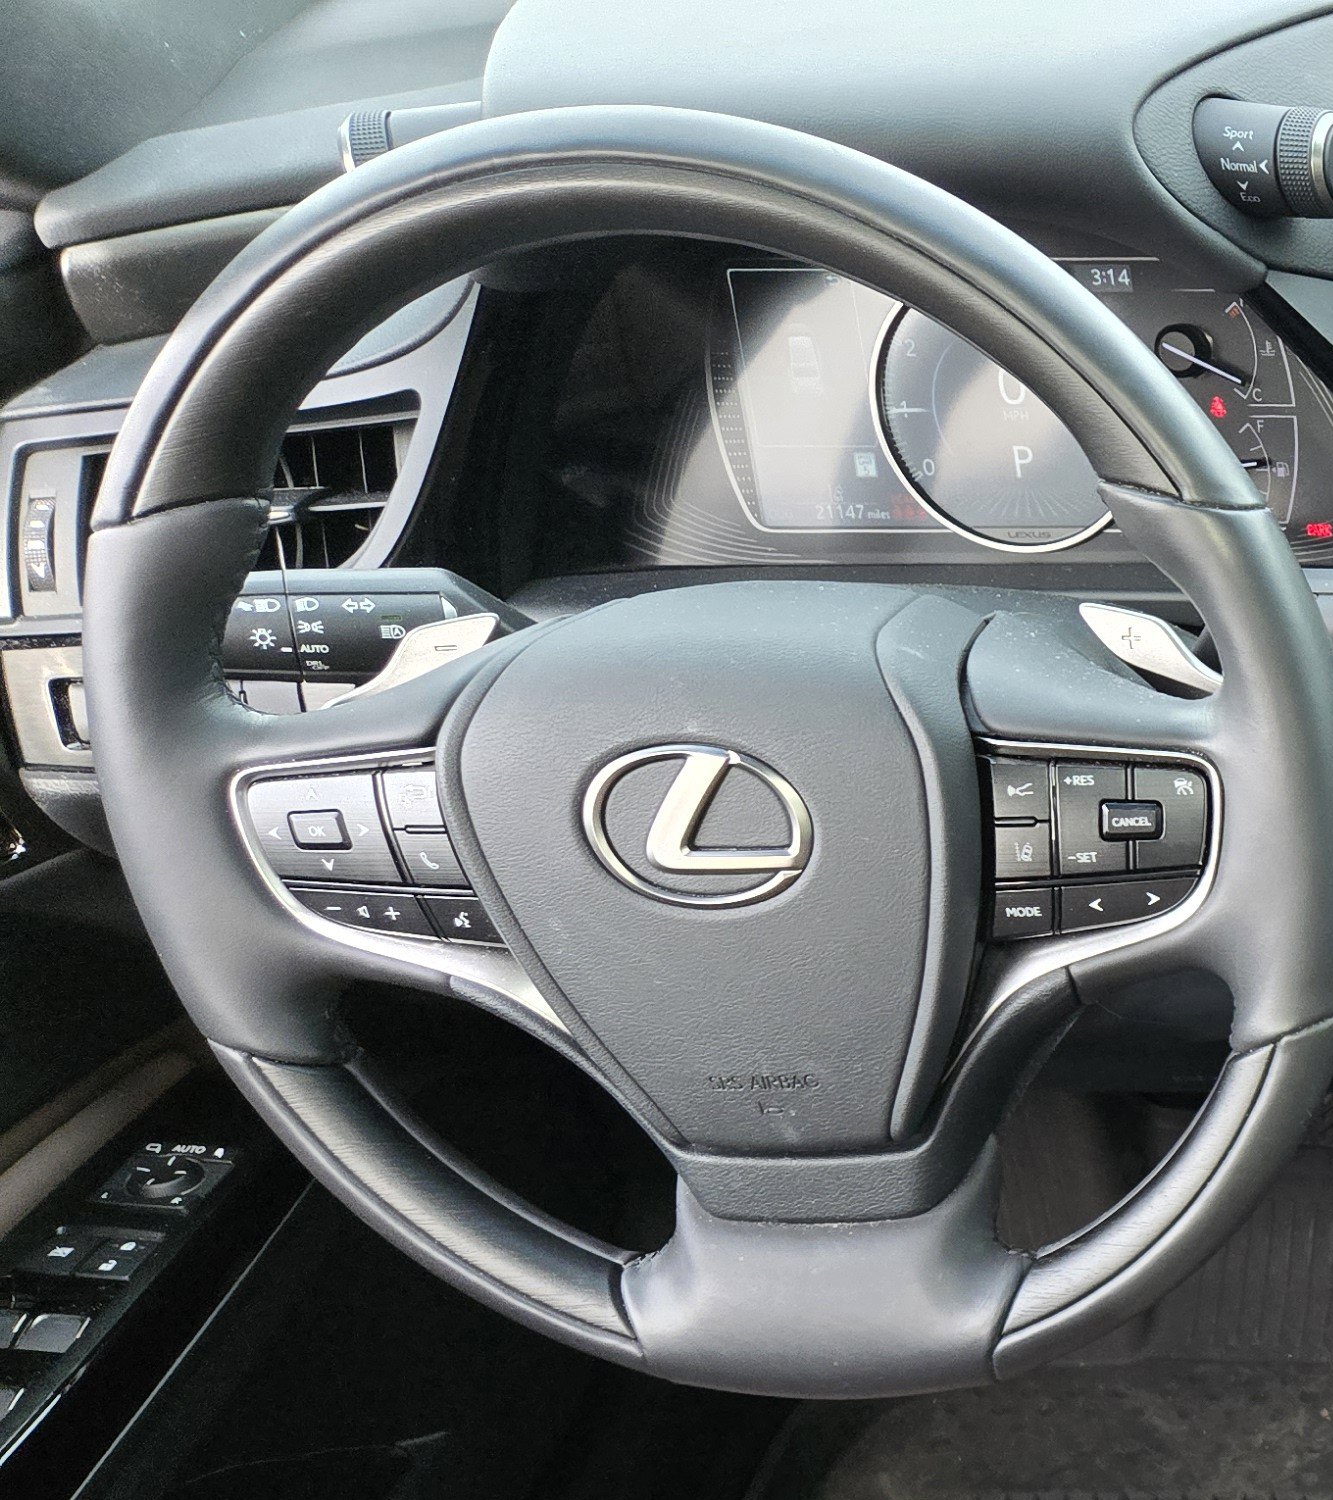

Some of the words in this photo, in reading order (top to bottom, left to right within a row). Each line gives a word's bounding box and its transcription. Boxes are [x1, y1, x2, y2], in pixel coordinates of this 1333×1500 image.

[1223, 126, 1253, 141] Sport
[1220, 157, 1258, 173] Normal
[1090, 268, 1131, 286] 3:14
[905, 338, 917, 357] 2
[1252, 388, 1262, 402] C
[1003, 411, 1030, 422] MPH
[1257, 420, 1264, 433] F
[922, 458, 935, 476] 0
[1013, 445, 1033, 478] P
[816, 504, 865, 520] 21147
[868, 509, 890, 519] miles
[1007, 531, 1052, 539] LEXUS
[1306, 524, 1333, 538] PARK
[300, 644, 330, 653] AUTO
[1111, 816, 1152, 827] CANCEL
[307, 825, 325, 837] OK
[1005, 906, 1042, 917] MODE
[708, 1074, 743, 1091] SRS
[750, 1074, 820, 1091] AIRBAG
[171, 1144, 207, 1155] AUTO
